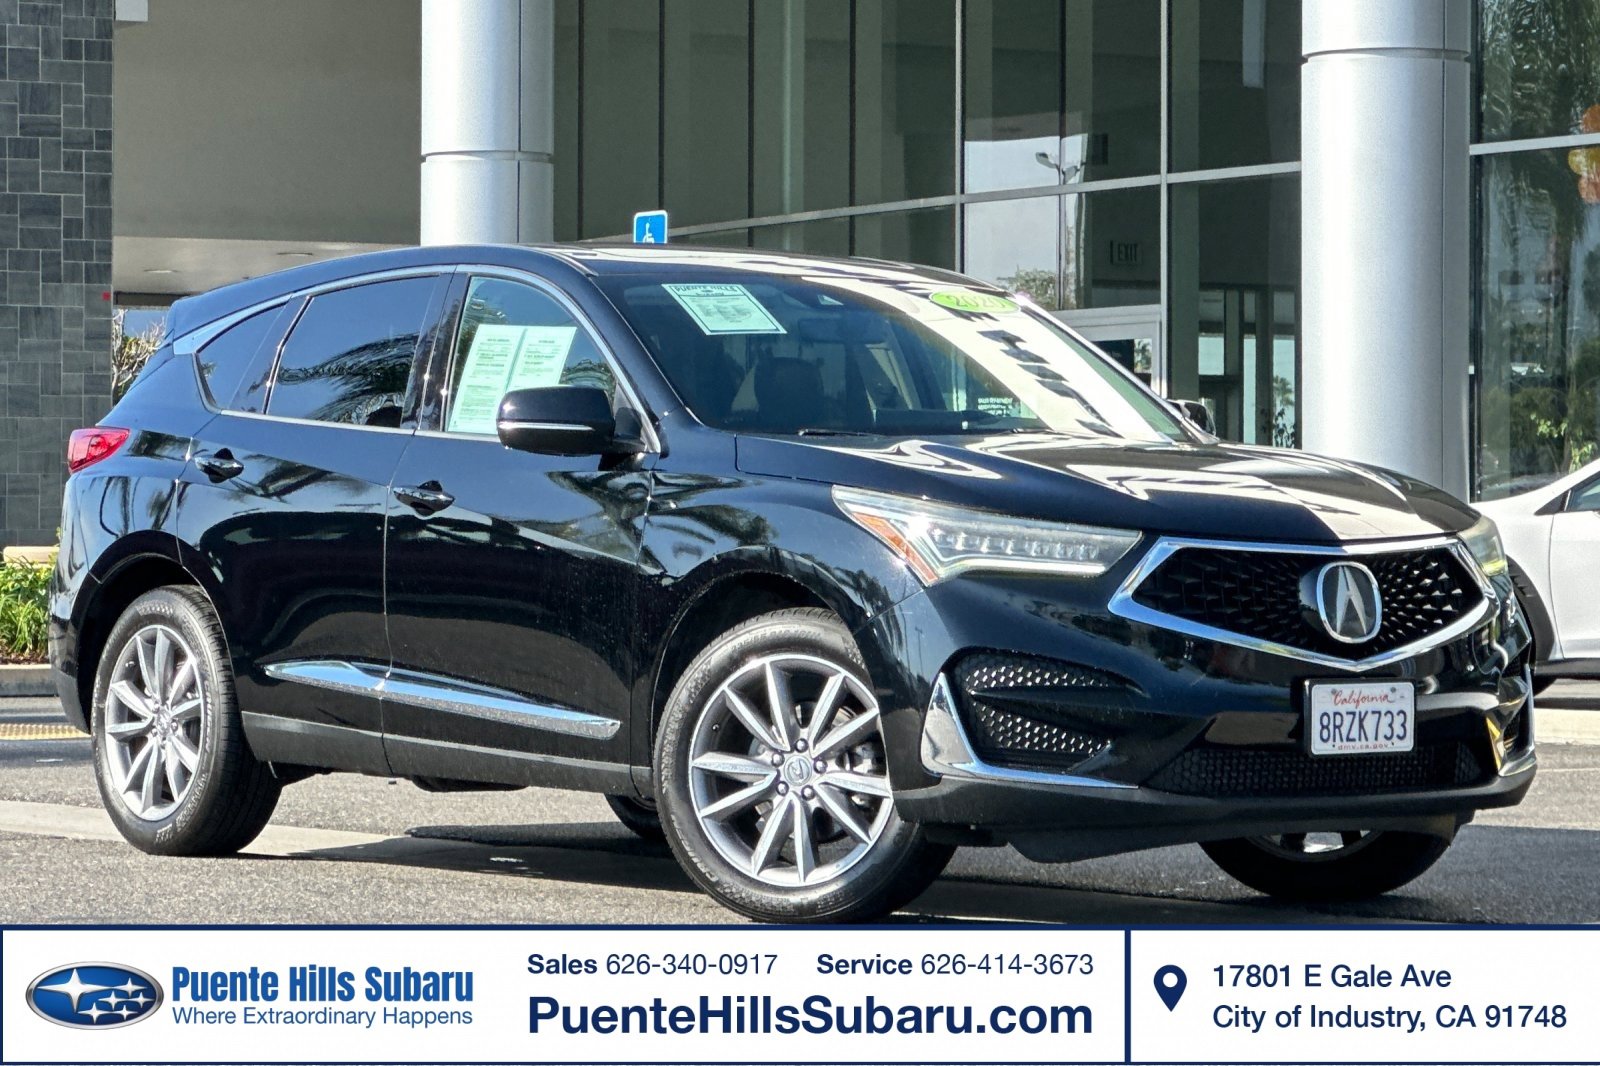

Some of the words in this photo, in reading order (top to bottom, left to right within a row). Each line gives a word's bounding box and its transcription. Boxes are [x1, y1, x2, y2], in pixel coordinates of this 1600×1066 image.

[1118, 243, 1138, 261] EXIT
[1333, 689, 1395, 709] California
[1319, 709, 1408, 743] 8RZK733
[1337, 743, 1389, 751] dmv.ca.gov
